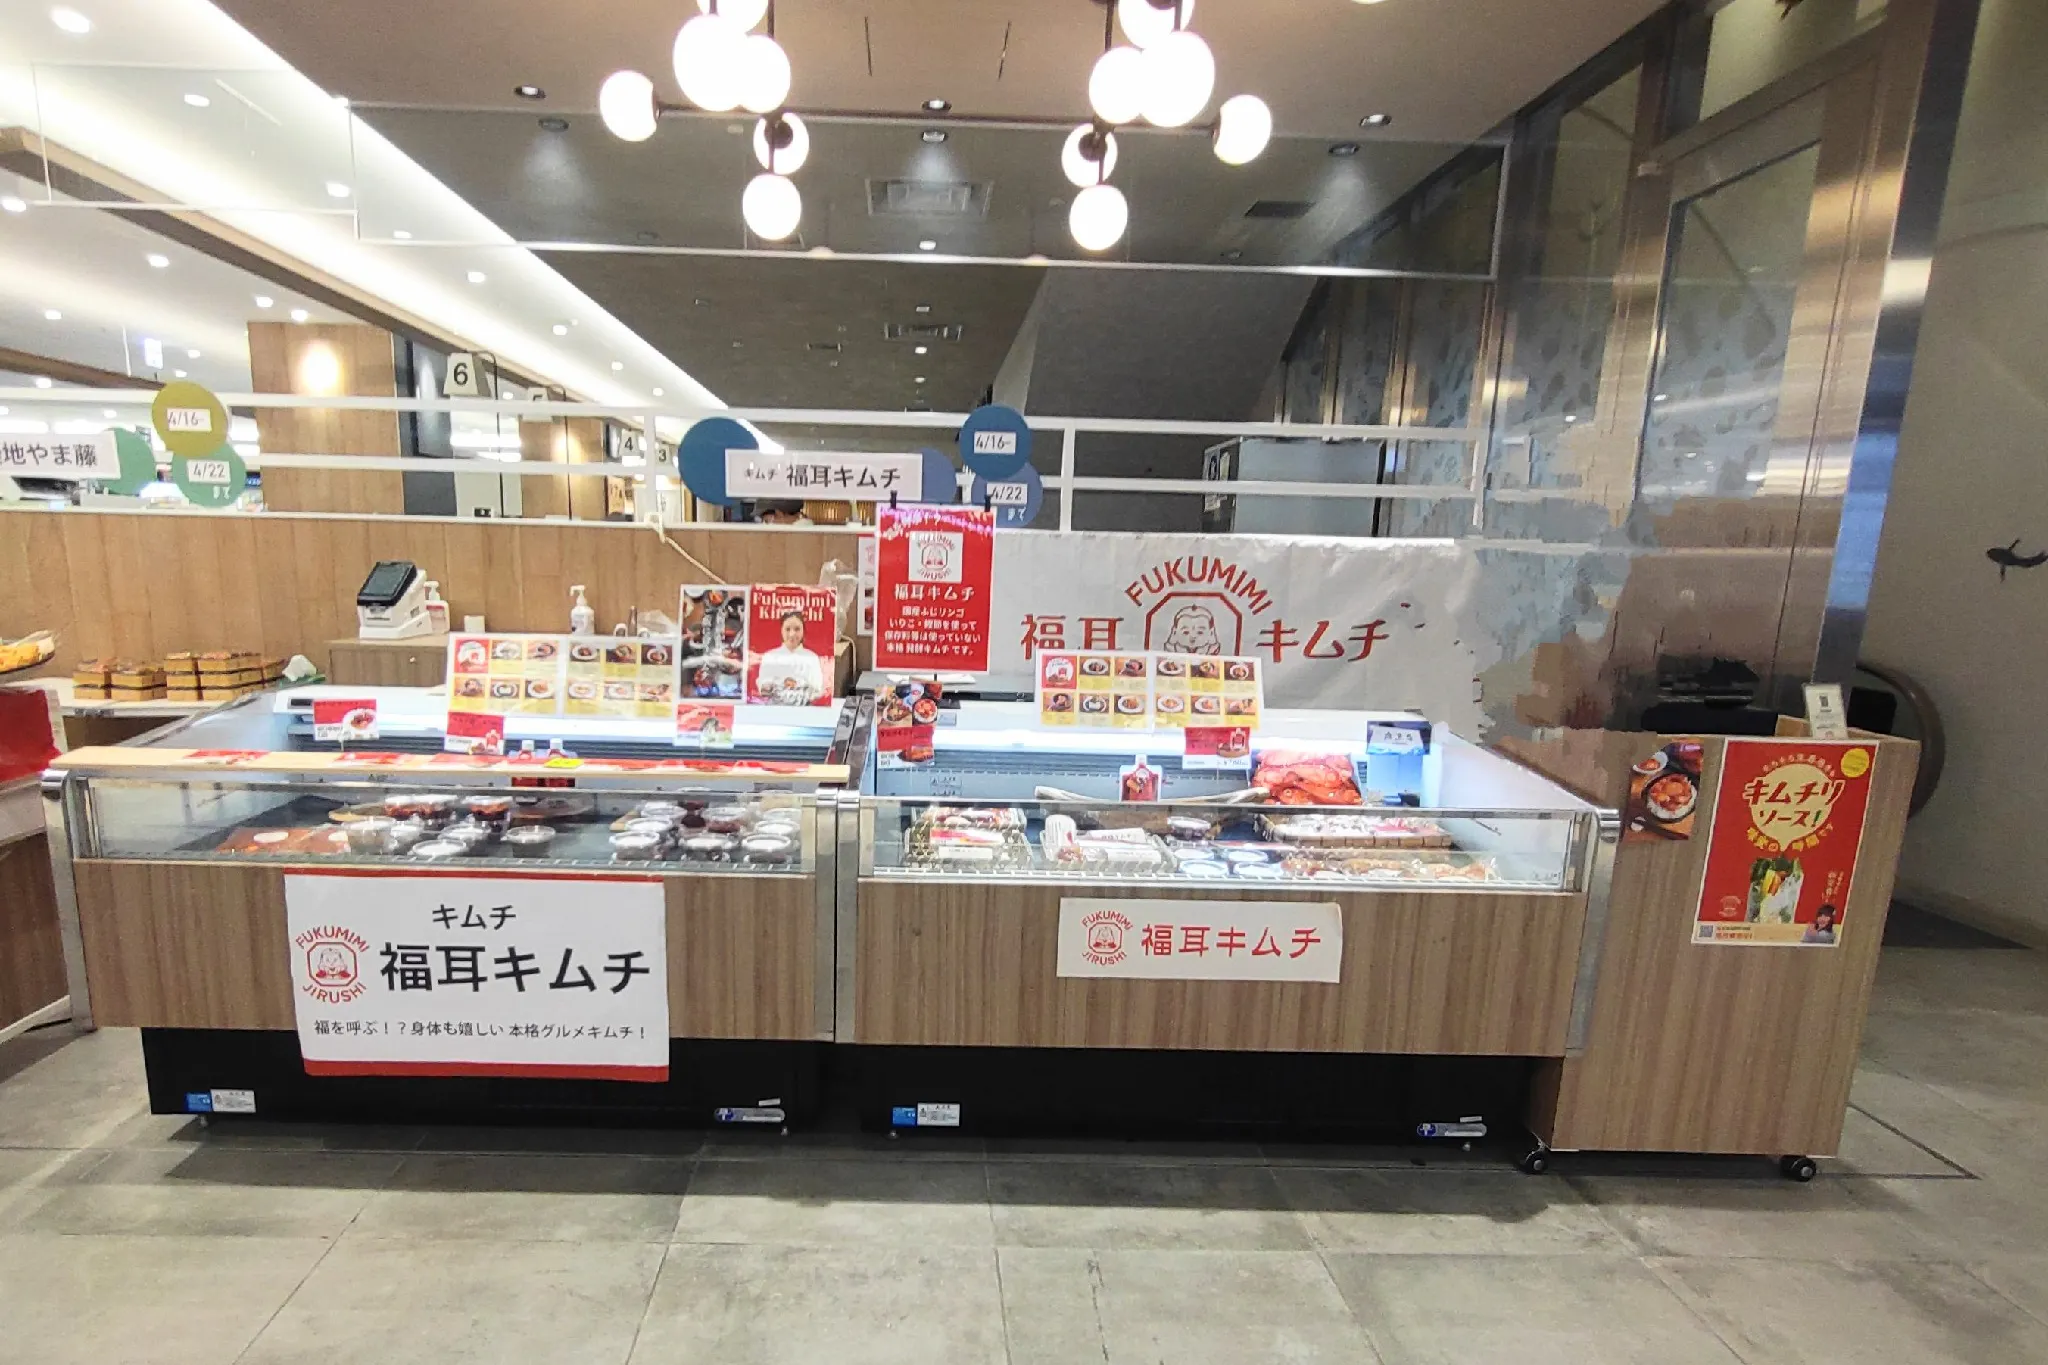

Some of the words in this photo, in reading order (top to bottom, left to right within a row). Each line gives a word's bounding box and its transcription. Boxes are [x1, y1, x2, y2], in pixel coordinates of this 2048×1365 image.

[453, 362, 469, 388] 6
[0, 442, 98, 467] 地やま藤
[624, 436, 633, 451] 4
[658, 448, 667, 463] 3
[193, 462, 226, 479] 4/22
[744, 467, 779, 481] キムチ
[786, 463, 901, 489] 福耳キムチ
[990, 486, 1022, 501] 4/22
[894, 583, 975, 601] 福耳キムチ
[1124, 555, 1274, 616] FUKUMIMI
[1255, 618, 1390, 664] キムチ
[1744, 779, 1844, 806] キムチリ
[432, 903, 517, 931] キムチ
[1081, 910, 1133, 931] FUKUMIMI
[295, 925, 370, 953] FUKUMIMI
[1141, 923, 1321, 959] 福耳キムチ
[379, 941, 651, 994] 福耳キムチ
[1082, 951, 1128, 966] JIRUSHI
[302, 981, 367, 1004] JIRUSHI
